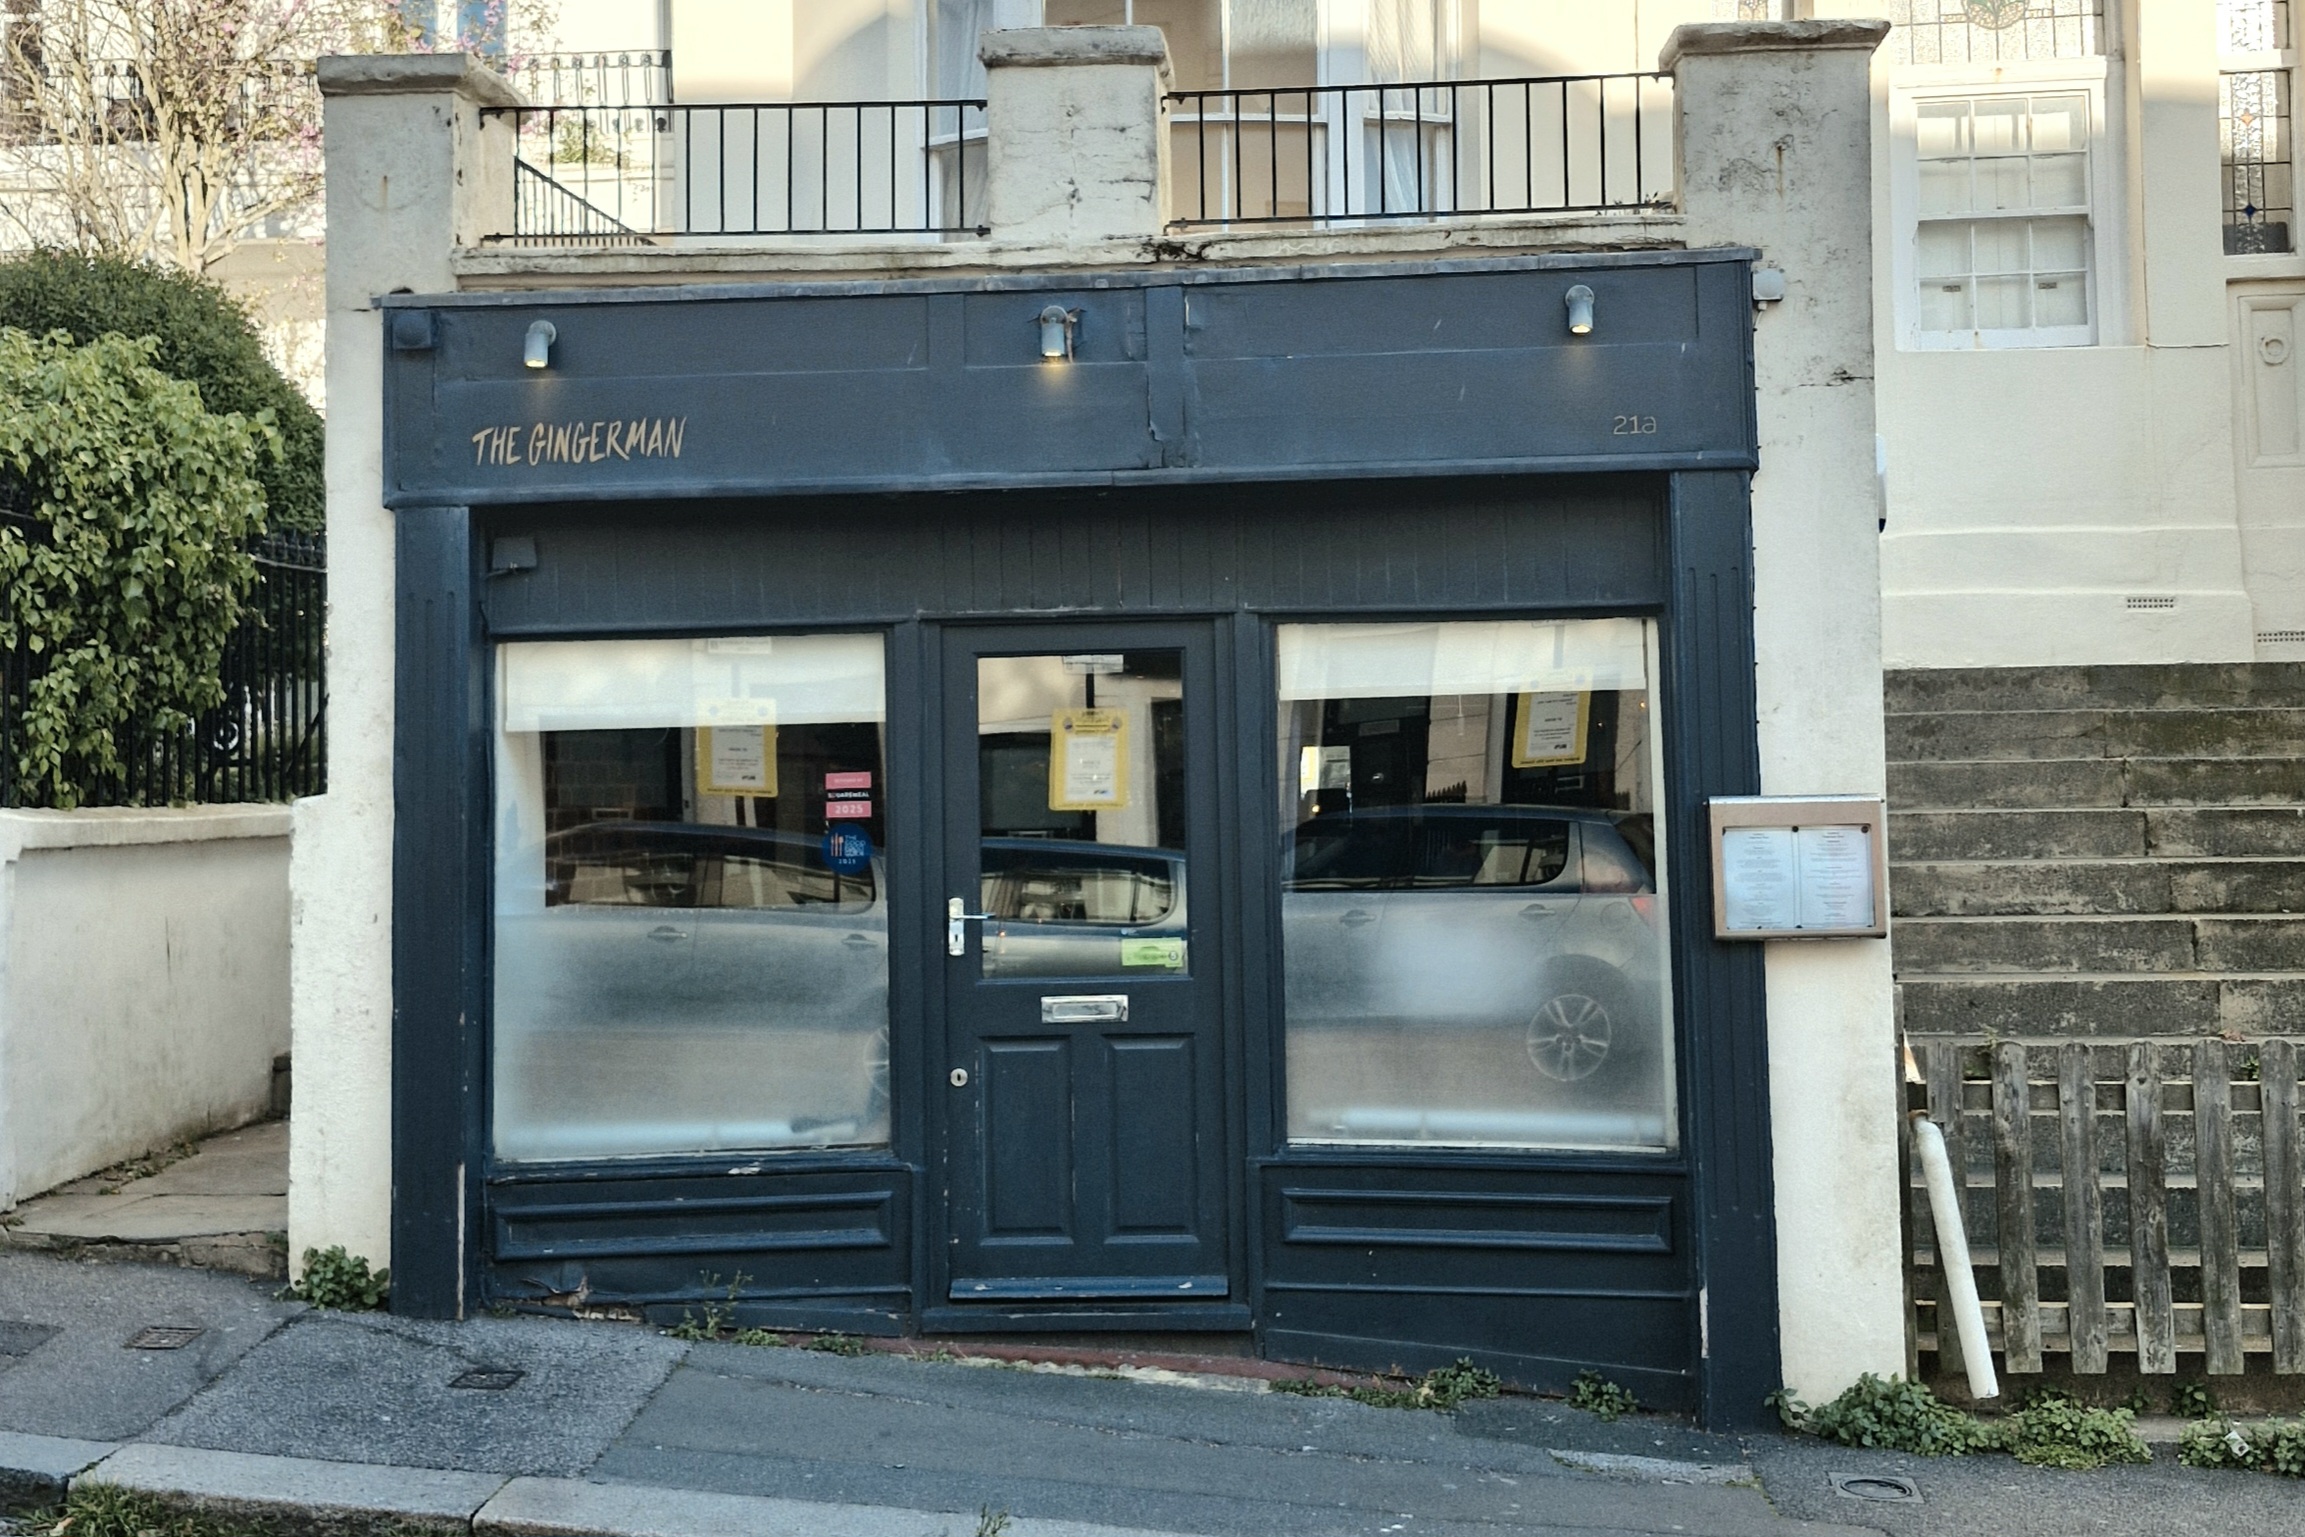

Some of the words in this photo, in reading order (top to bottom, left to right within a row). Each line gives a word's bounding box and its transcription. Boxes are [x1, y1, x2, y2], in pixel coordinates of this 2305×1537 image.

[1613, 415, 1657, 435] 21a
[472, 426, 521, 466] THE
[528, 416, 687, 466] GINGERMAN
[835, 804, 863, 814] 2025
